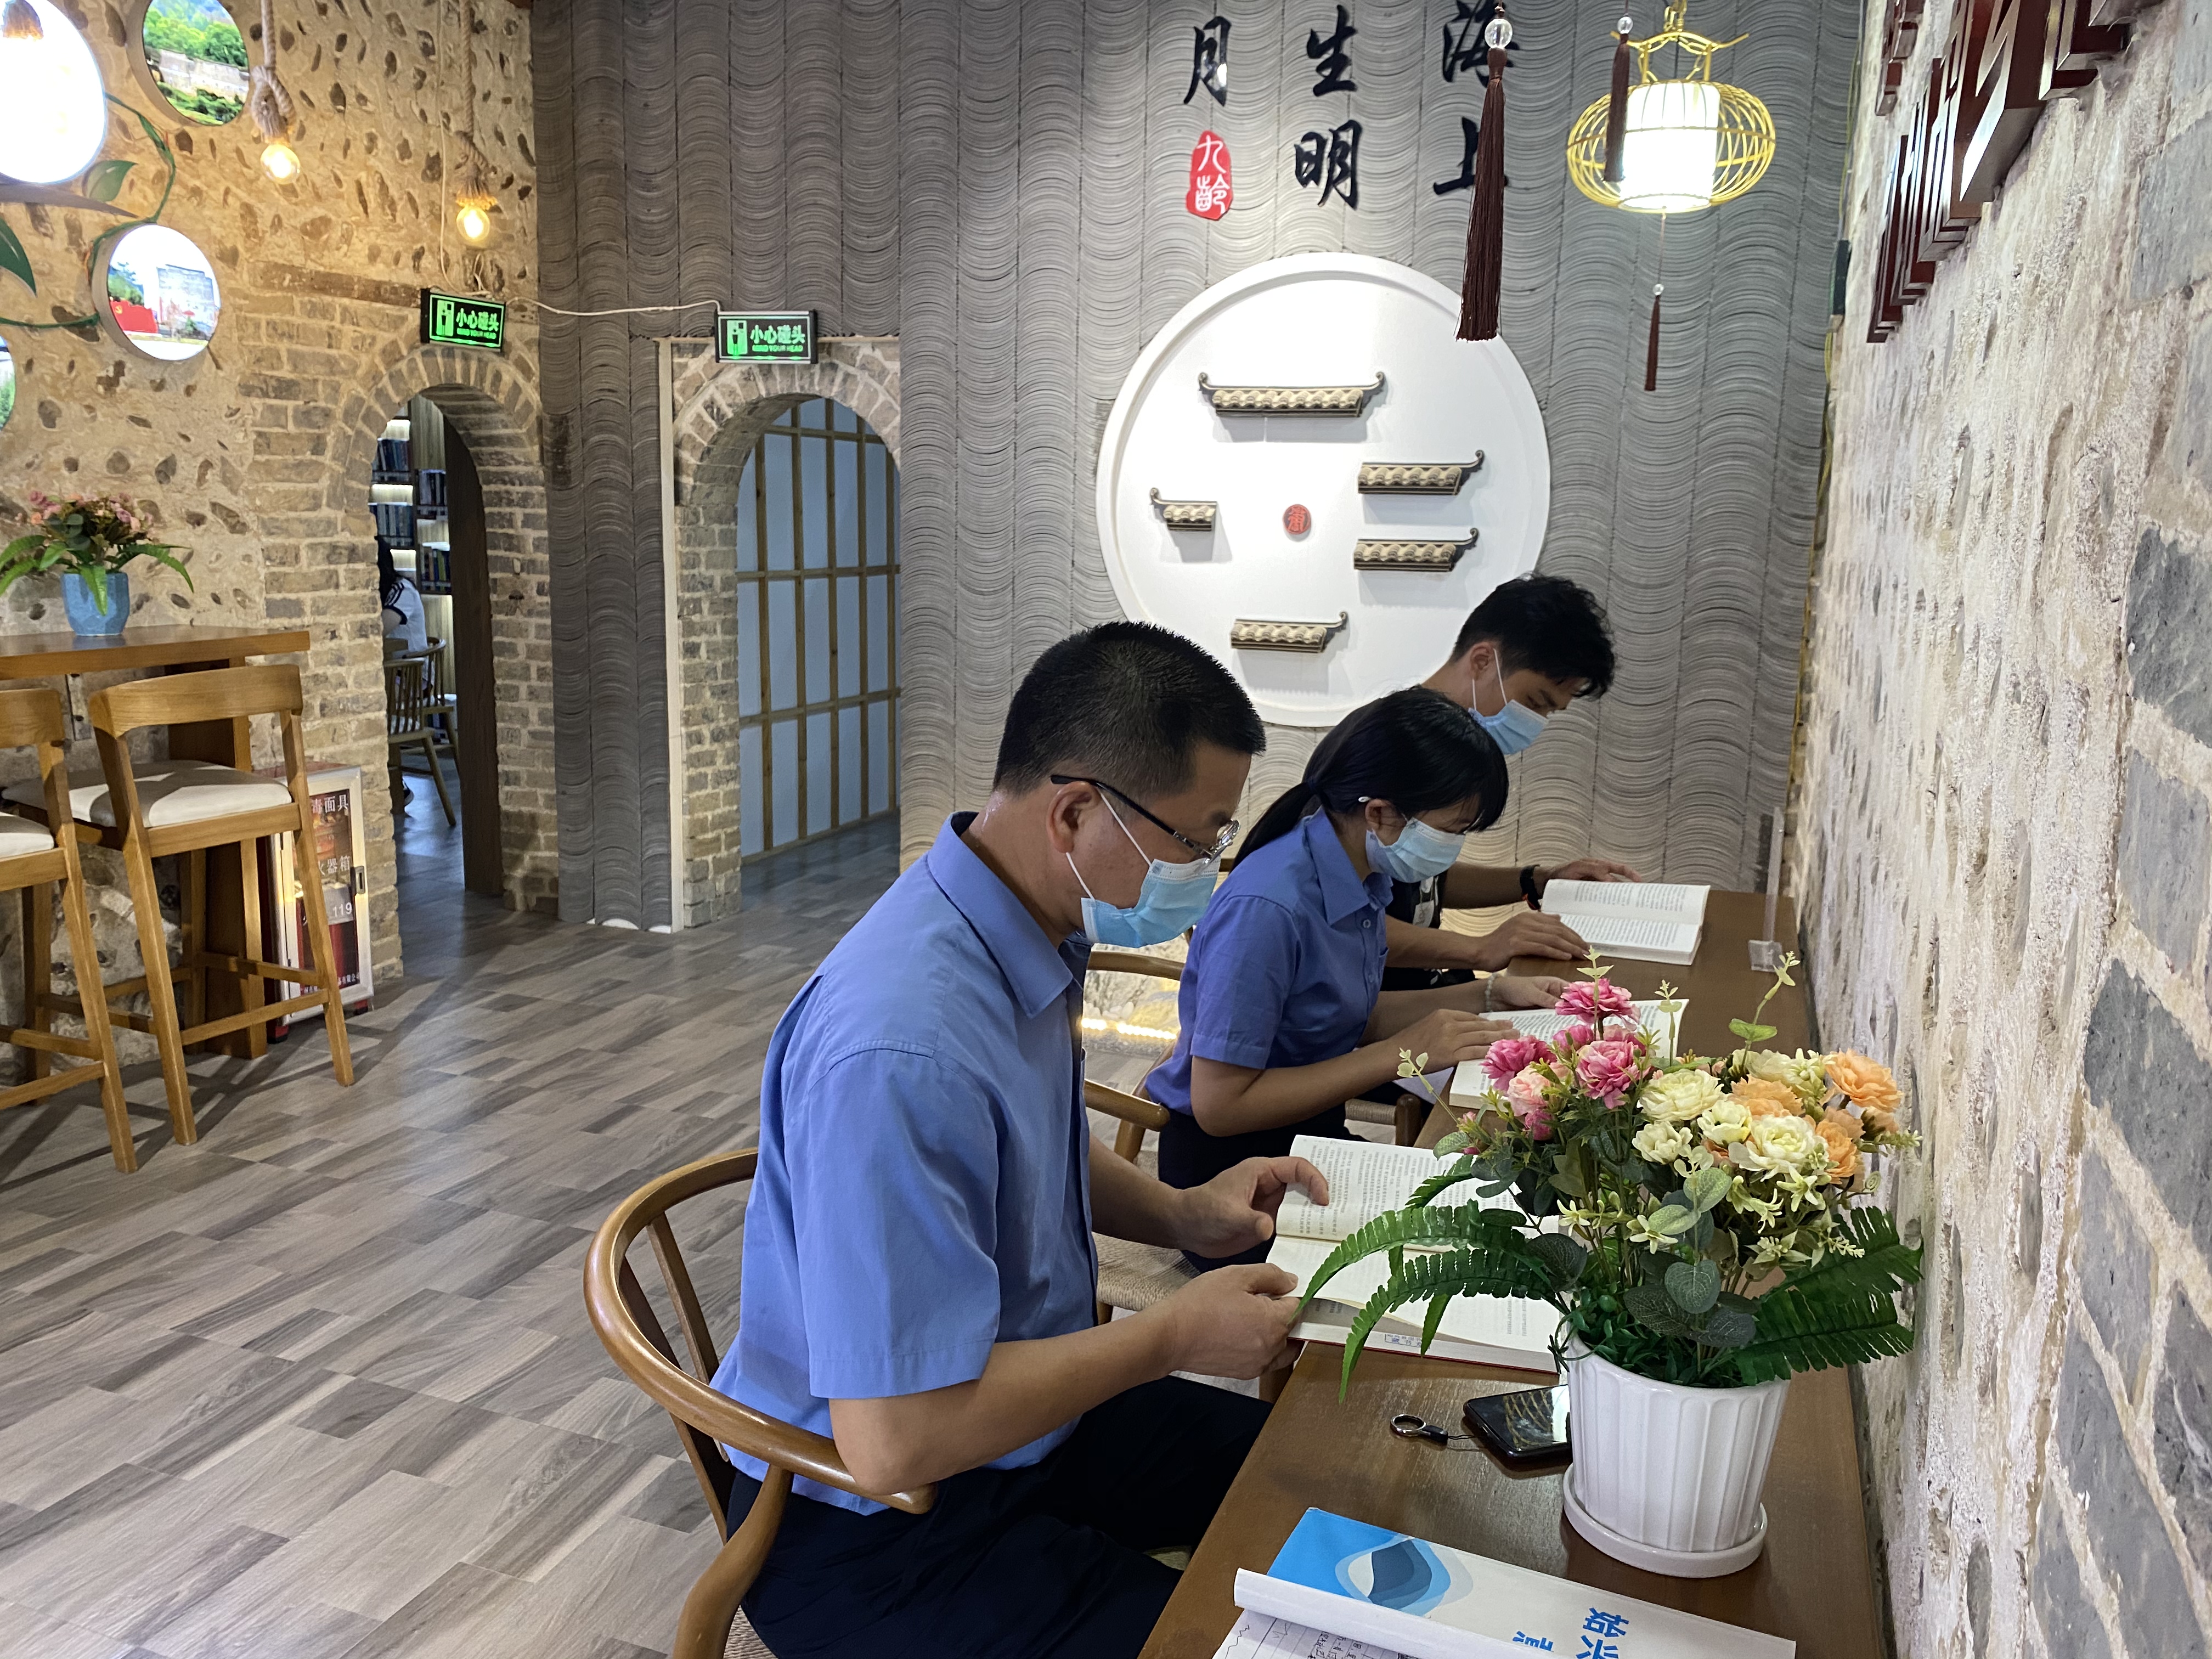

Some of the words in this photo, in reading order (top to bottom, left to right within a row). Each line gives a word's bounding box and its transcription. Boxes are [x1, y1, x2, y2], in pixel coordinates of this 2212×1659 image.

[1182, 14, 1232, 108] 月
[1294, 4, 1364, 211] 生明
[455, 307, 499, 332] 小心碰头
[749, 324, 806, 345] 小心碰头
[332, 901, 353, 918] 119
